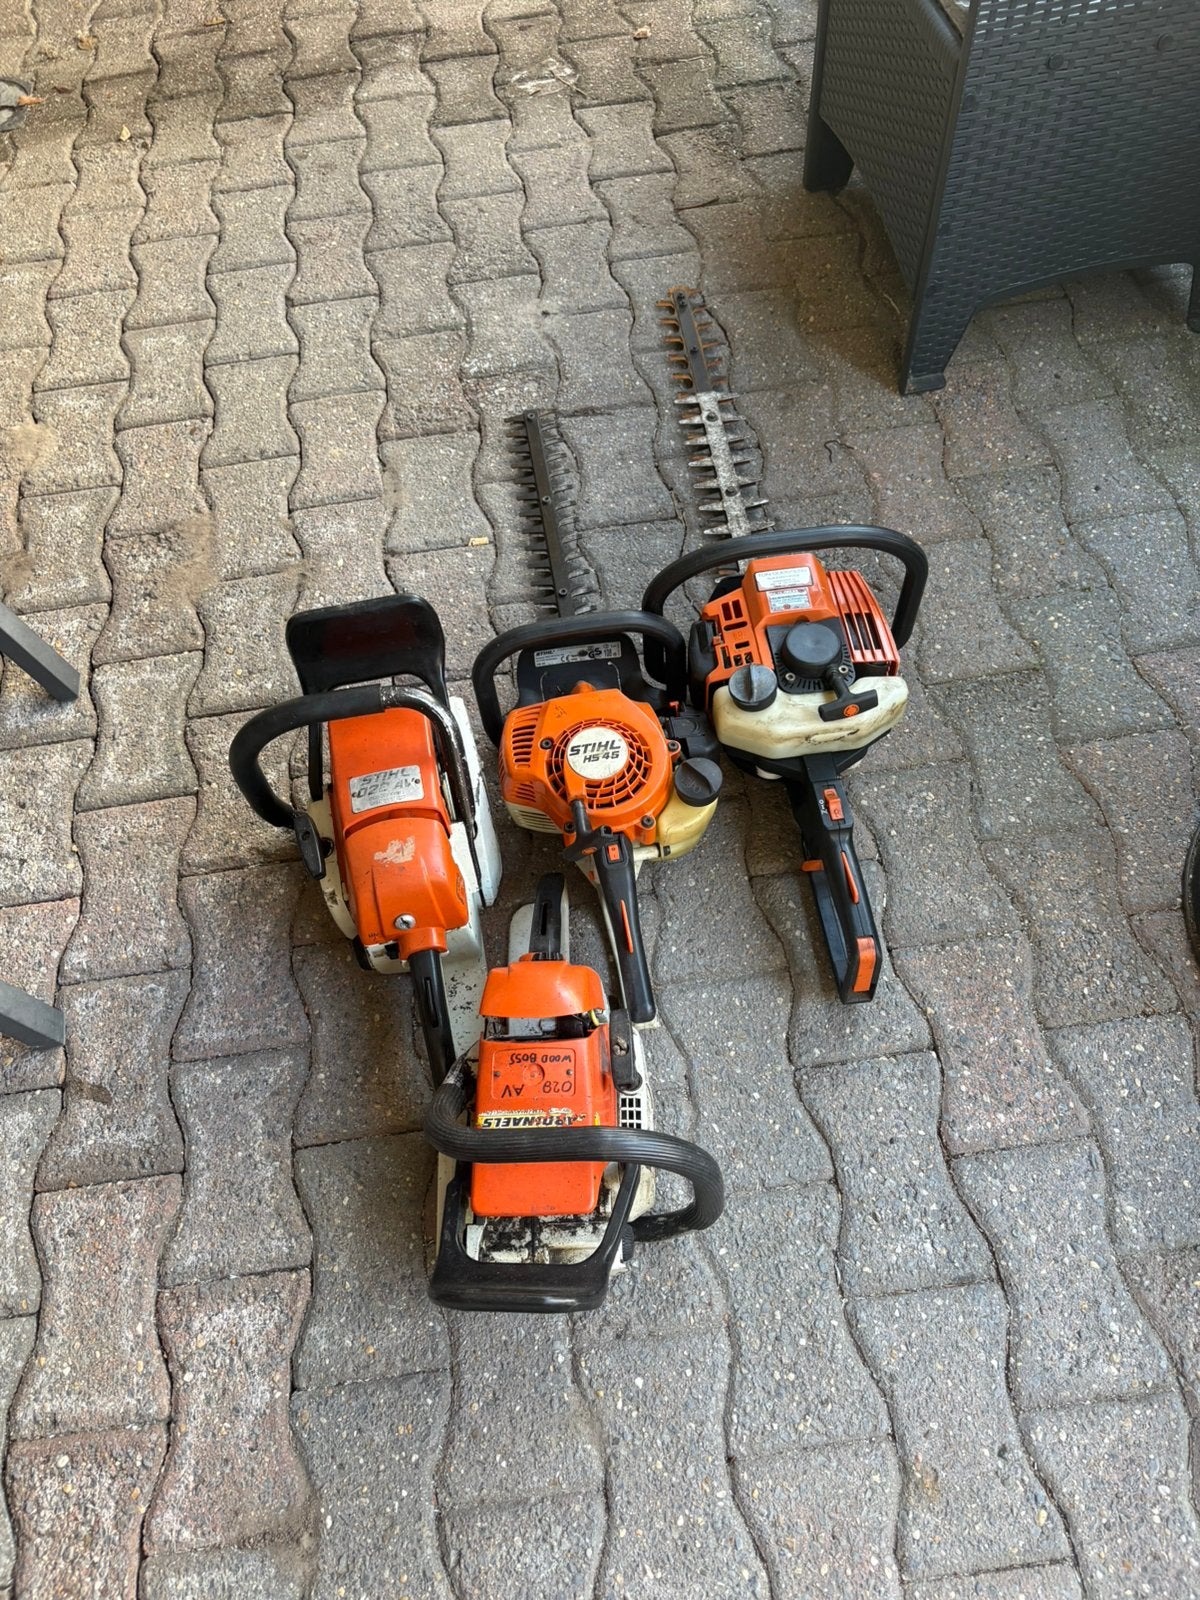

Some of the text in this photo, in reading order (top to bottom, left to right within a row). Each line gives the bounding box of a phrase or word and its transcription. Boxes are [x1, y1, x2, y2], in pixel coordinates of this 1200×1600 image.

[569, 739, 621, 756] STIHL
[583, 750, 620, 764] HS 45
[361, 767, 411, 786] STIHL
[509, 1052, 572, 1065] WOOD BOSS
[502, 1080, 572, 1098] 028 AV
